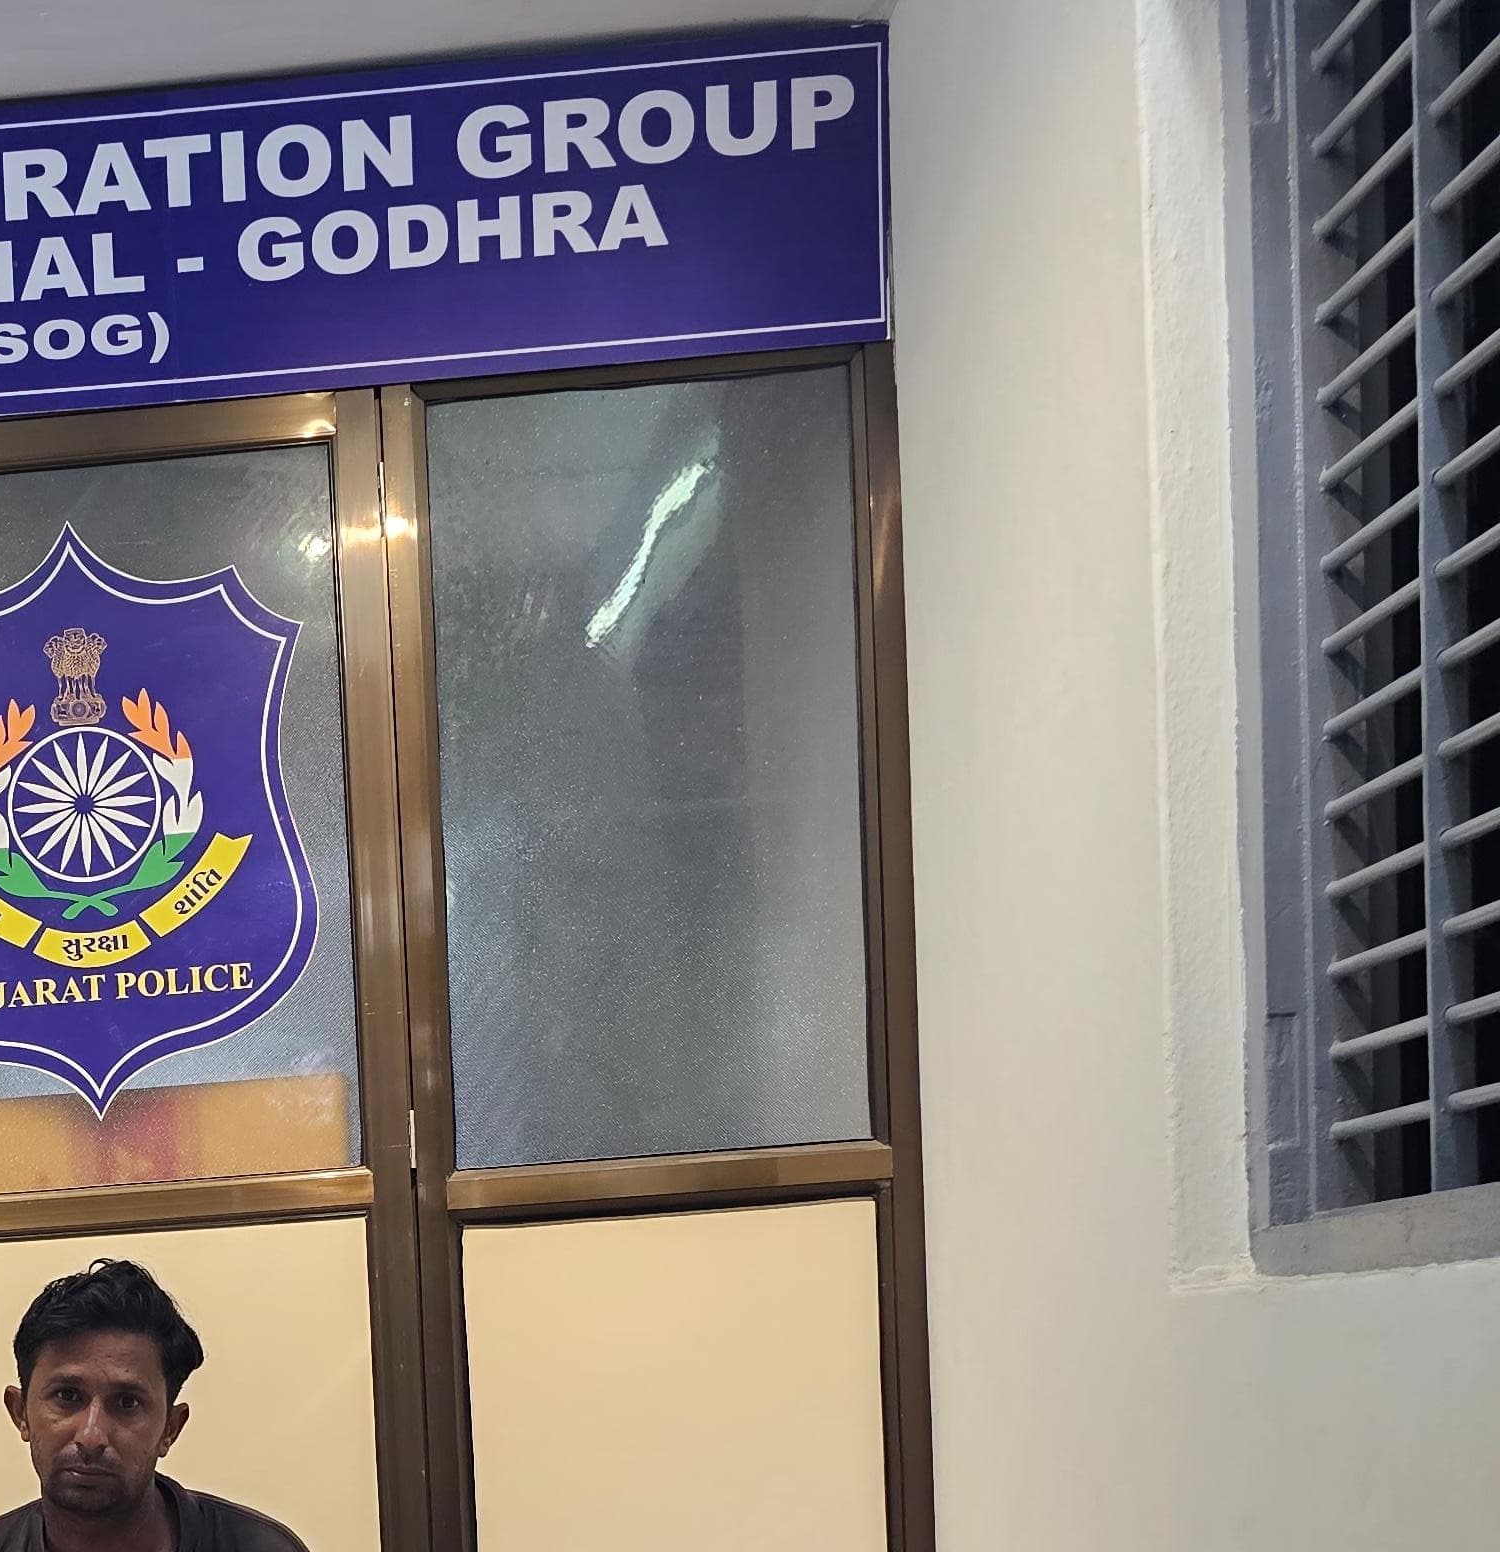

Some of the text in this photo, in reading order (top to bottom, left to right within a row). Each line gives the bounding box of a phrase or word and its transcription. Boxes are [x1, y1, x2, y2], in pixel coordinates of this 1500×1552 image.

[456, 74, 855, 179] GROUP
[176, 256, 205, 274] -
[237, 184, 669, 282] GODHRA
[61, 933, 129, 961] સુરક્ષા
[173, 867, 223, 916] શાંતિ
[114, 962, 254, 1000] POLICE
